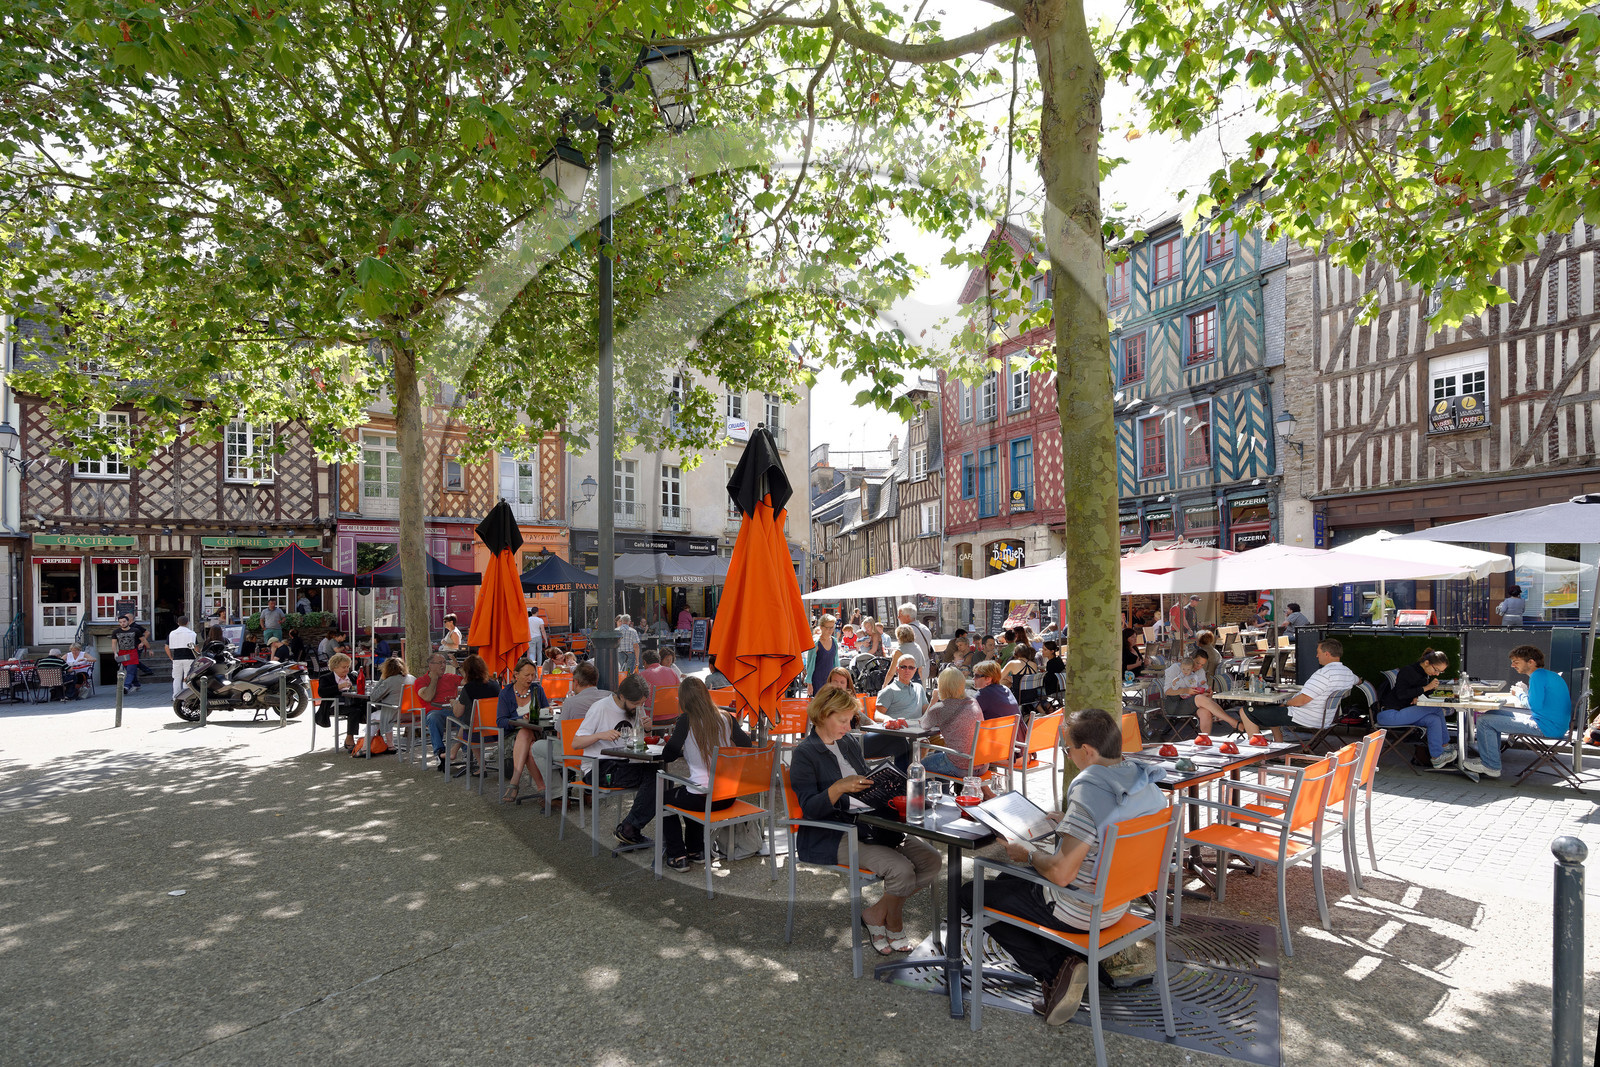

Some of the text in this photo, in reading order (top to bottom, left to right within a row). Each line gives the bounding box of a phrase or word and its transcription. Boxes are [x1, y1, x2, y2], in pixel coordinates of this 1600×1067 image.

[1234, 498, 1266, 506] PIZZERIA
[57, 536, 112, 545] GLACIER
[217, 538, 262, 546] CREPERIE
[243, 578, 343, 587] CREPERIE STE ANNE
[672, 575, 705, 583] BRASSERIE
[536, 583, 572, 591] CREPERIE
